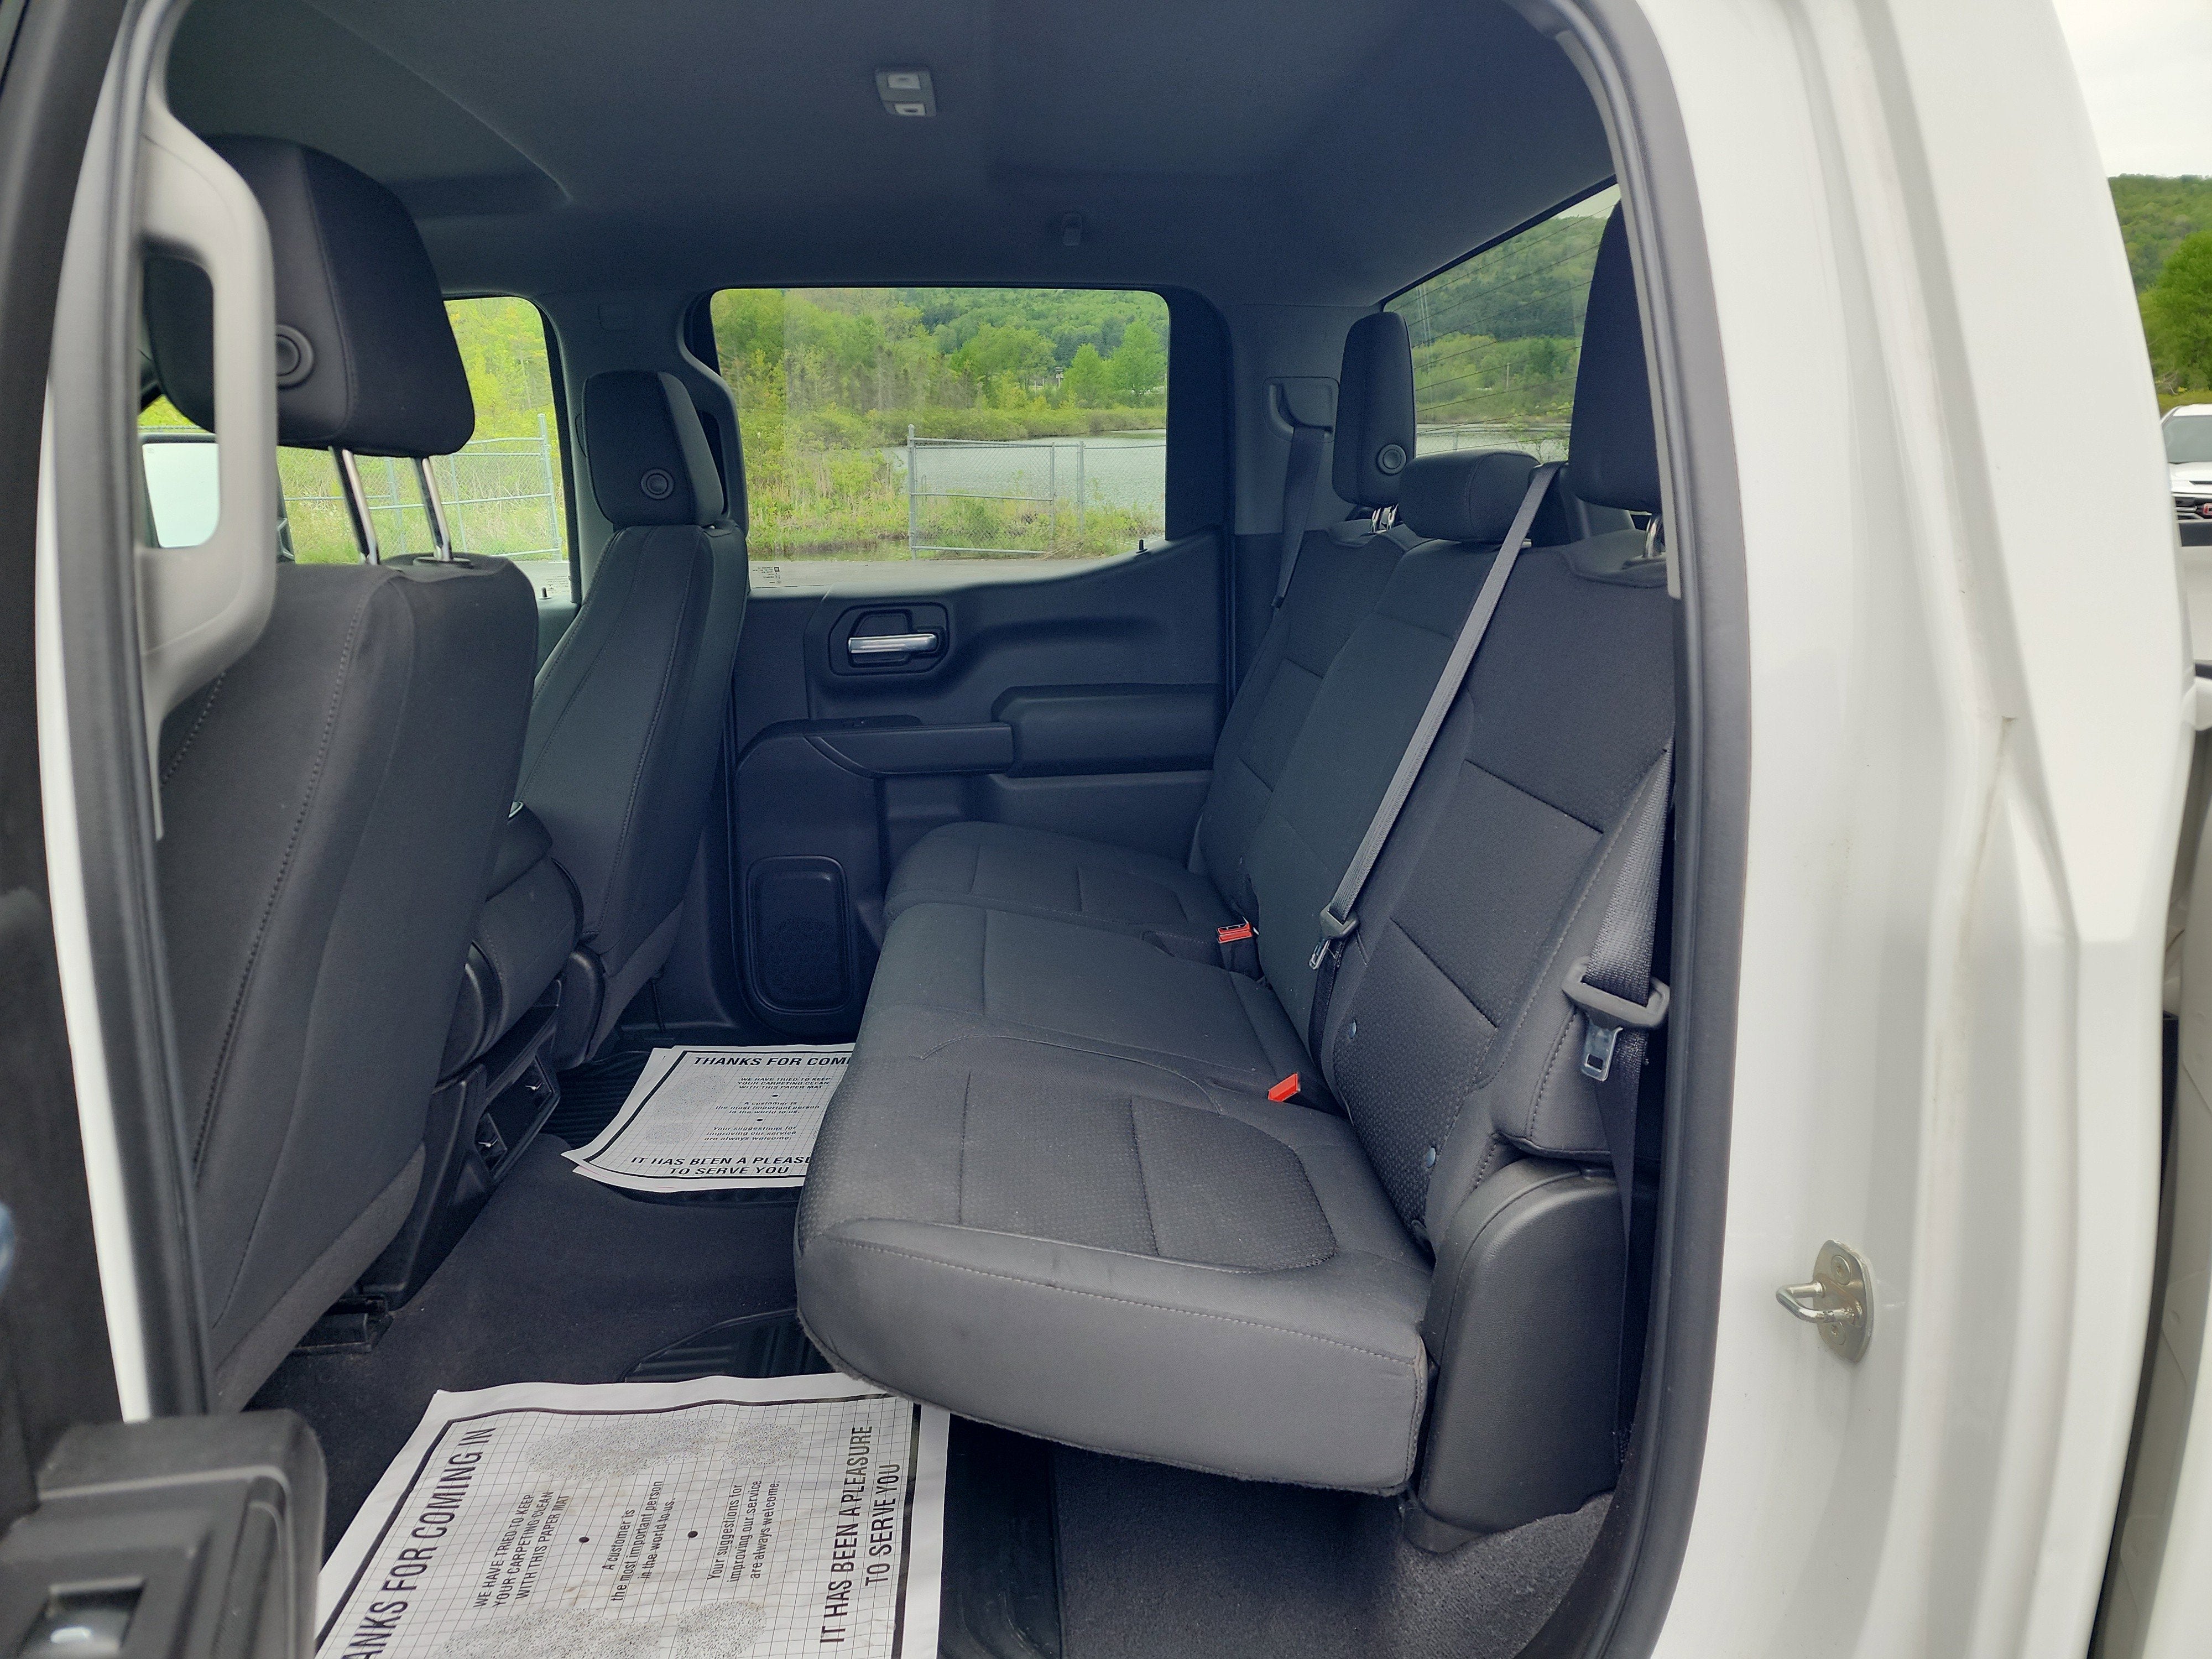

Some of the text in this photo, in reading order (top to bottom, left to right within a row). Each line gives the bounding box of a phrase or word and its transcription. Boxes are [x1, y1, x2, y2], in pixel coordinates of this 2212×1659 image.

[693, 1057, 762, 1066] THANKS
[766, 1057, 802, 1066] FOR
[381, 1547, 438, 1590] FOR
[411, 1451, 484, 1538] COMING
[457, 1427, 497, 1446] IN
[473, 1494, 534, 1608] WE HAVE TRIED TO KEEP
[492, 1491, 554, 1608] YOUR CARPETING CLEAN
[515, 1495, 569, 1600] WITH THIS PAPER MAT
[608, 1521, 631, 1562] customer
[622, 1509, 635, 1518] is
[611, 1481, 663, 1601] the most important person
[650, 1525, 666, 1551] world
[657, 1512, 670, 1524] to
[663, 1498, 676, 1511] us.
[707, 1485, 743, 1580] Your suggestions for
[727, 1481, 761, 1583] improving our service
[750, 1481, 780, 1578] are always welcome.
[820, 1426, 872, 1643] IT HAS BEEN A PLEASURE
[865, 1463, 900, 1587] TO SERVE YOU
[642, 1553, 658, 1569] the
